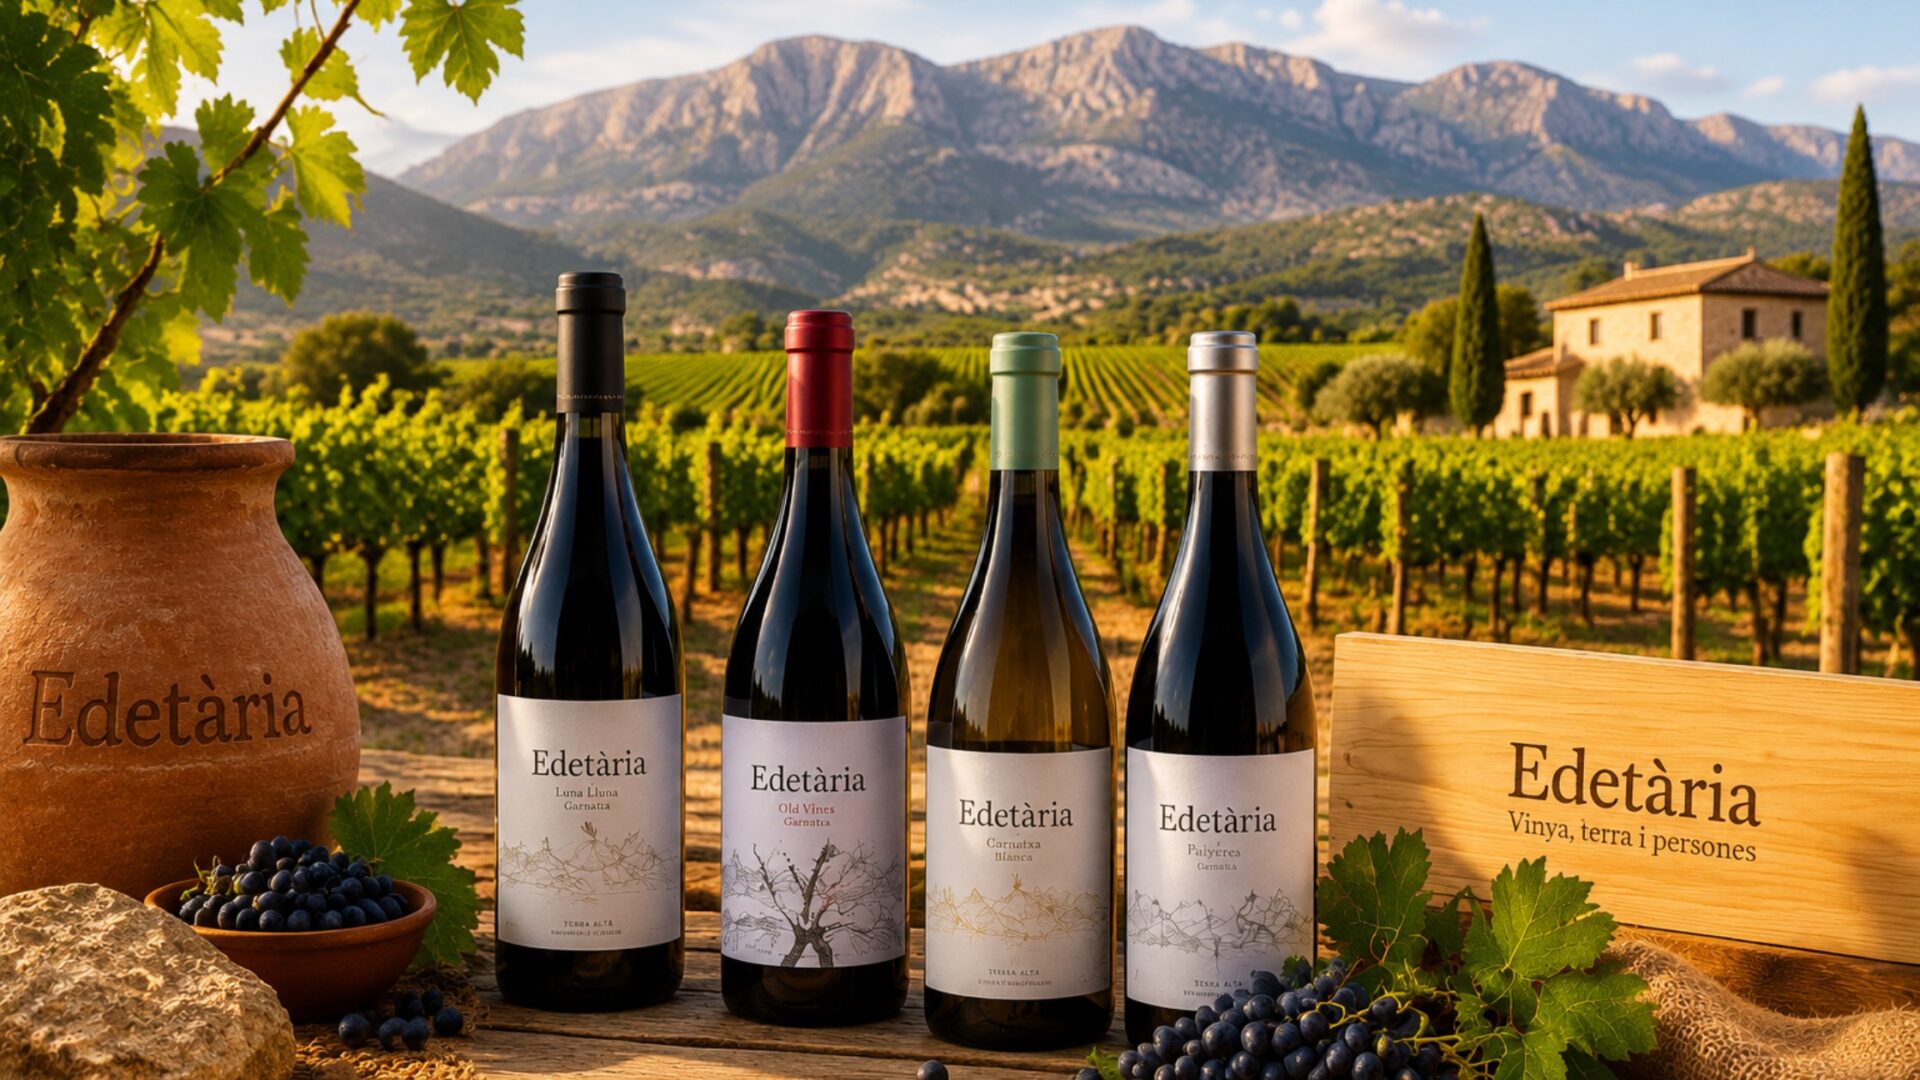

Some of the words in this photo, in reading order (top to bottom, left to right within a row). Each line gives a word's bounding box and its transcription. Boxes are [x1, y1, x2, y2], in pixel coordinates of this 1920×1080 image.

[22, 670, 312, 748] Edetària
[531, 749, 647, 777] Edetària
[555, 786, 583, 798] Luna
[751, 764, 866, 792] Edetària
[1508, 742, 1761, 827] Edetària
[778, 803, 799, 814] Old
[803, 804, 835, 815] Vines
[959, 798, 1073, 828] Edetària
[1159, 804, 1276, 833] Edetària
[1507, 810, 1575, 844] Vinya,
[1580, 819, 1632, 847] terra
[1639, 826, 1647, 849] i
[1652, 833, 1757, 862] persones
